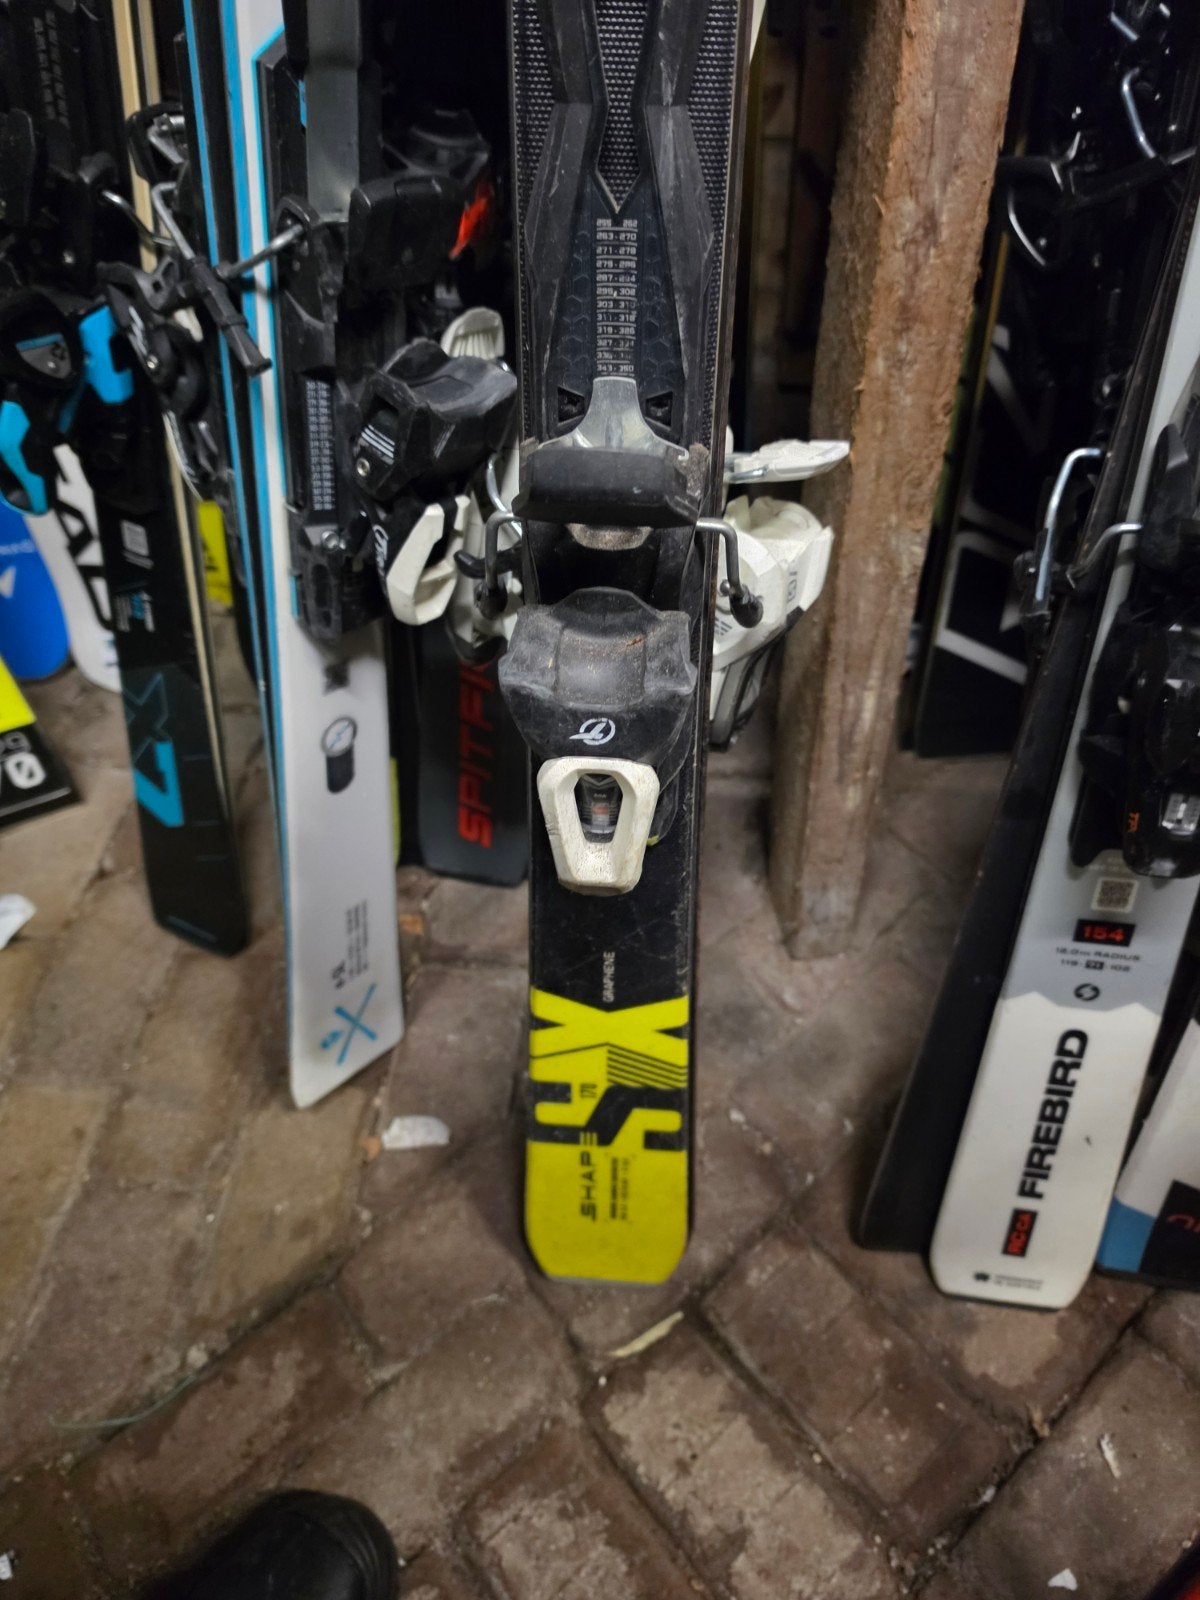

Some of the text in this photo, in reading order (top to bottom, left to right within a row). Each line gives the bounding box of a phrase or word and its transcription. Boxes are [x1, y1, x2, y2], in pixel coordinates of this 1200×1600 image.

[1083, 925, 1125, 943] 154
[1093, 951, 1141, 961] RADIUS
[602, 951, 616, 1002] GRAPHENE
[579, 1082, 597, 1100] 170
[1017, 1029, 1088, 1201] FIREBIRD
[579, 1131, 600, 1223] SHAPE
